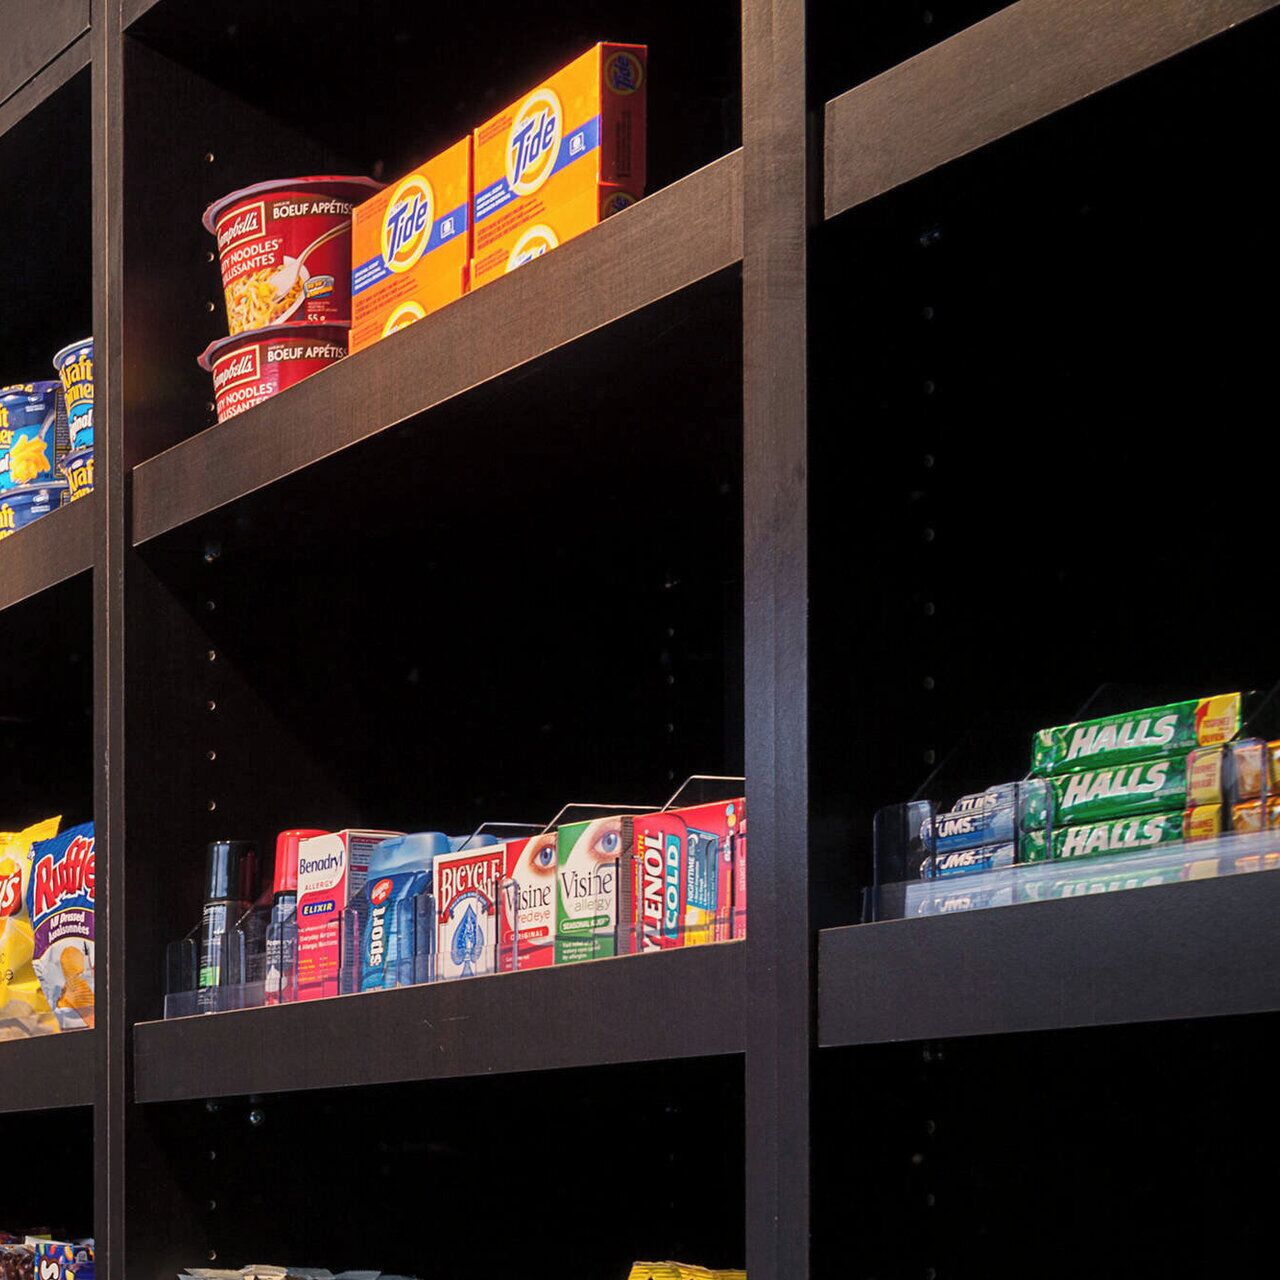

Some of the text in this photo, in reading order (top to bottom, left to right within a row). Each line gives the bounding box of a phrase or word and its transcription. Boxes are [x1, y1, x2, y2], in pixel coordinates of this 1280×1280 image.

[509, 107, 556, 191] Tide
[273, 203, 310, 219] BOEUF
[385, 192, 428, 267] Tide
[230, 239, 279, 261] NOODLES
[267, 350, 303, 363] BOEUF
[226, 383, 273, 405] NOODLES
[1067, 714, 1179, 761] HALLS
[1061, 762, 1170, 810] HALLS
[935, 815, 972, 838] TUMS
[1061, 815, 1167, 858] HALLS
[299, 850, 344, 875] Benadryl
[935, 850, 973, 870] TUMS
[304, 880, 333, 891] ALLERGY
[441, 859, 500, 917] BICYCLE
[561, 870, 613, 900] Visine
[666, 845, 679, 929] COLD
[303, 902, 333, 915] ELIXIR
[504, 884, 552, 912] Visine
[575, 899, 611, 913] allergy
[50, 911, 85, 928] All Dressed
[370, 906, 386, 966] sport
